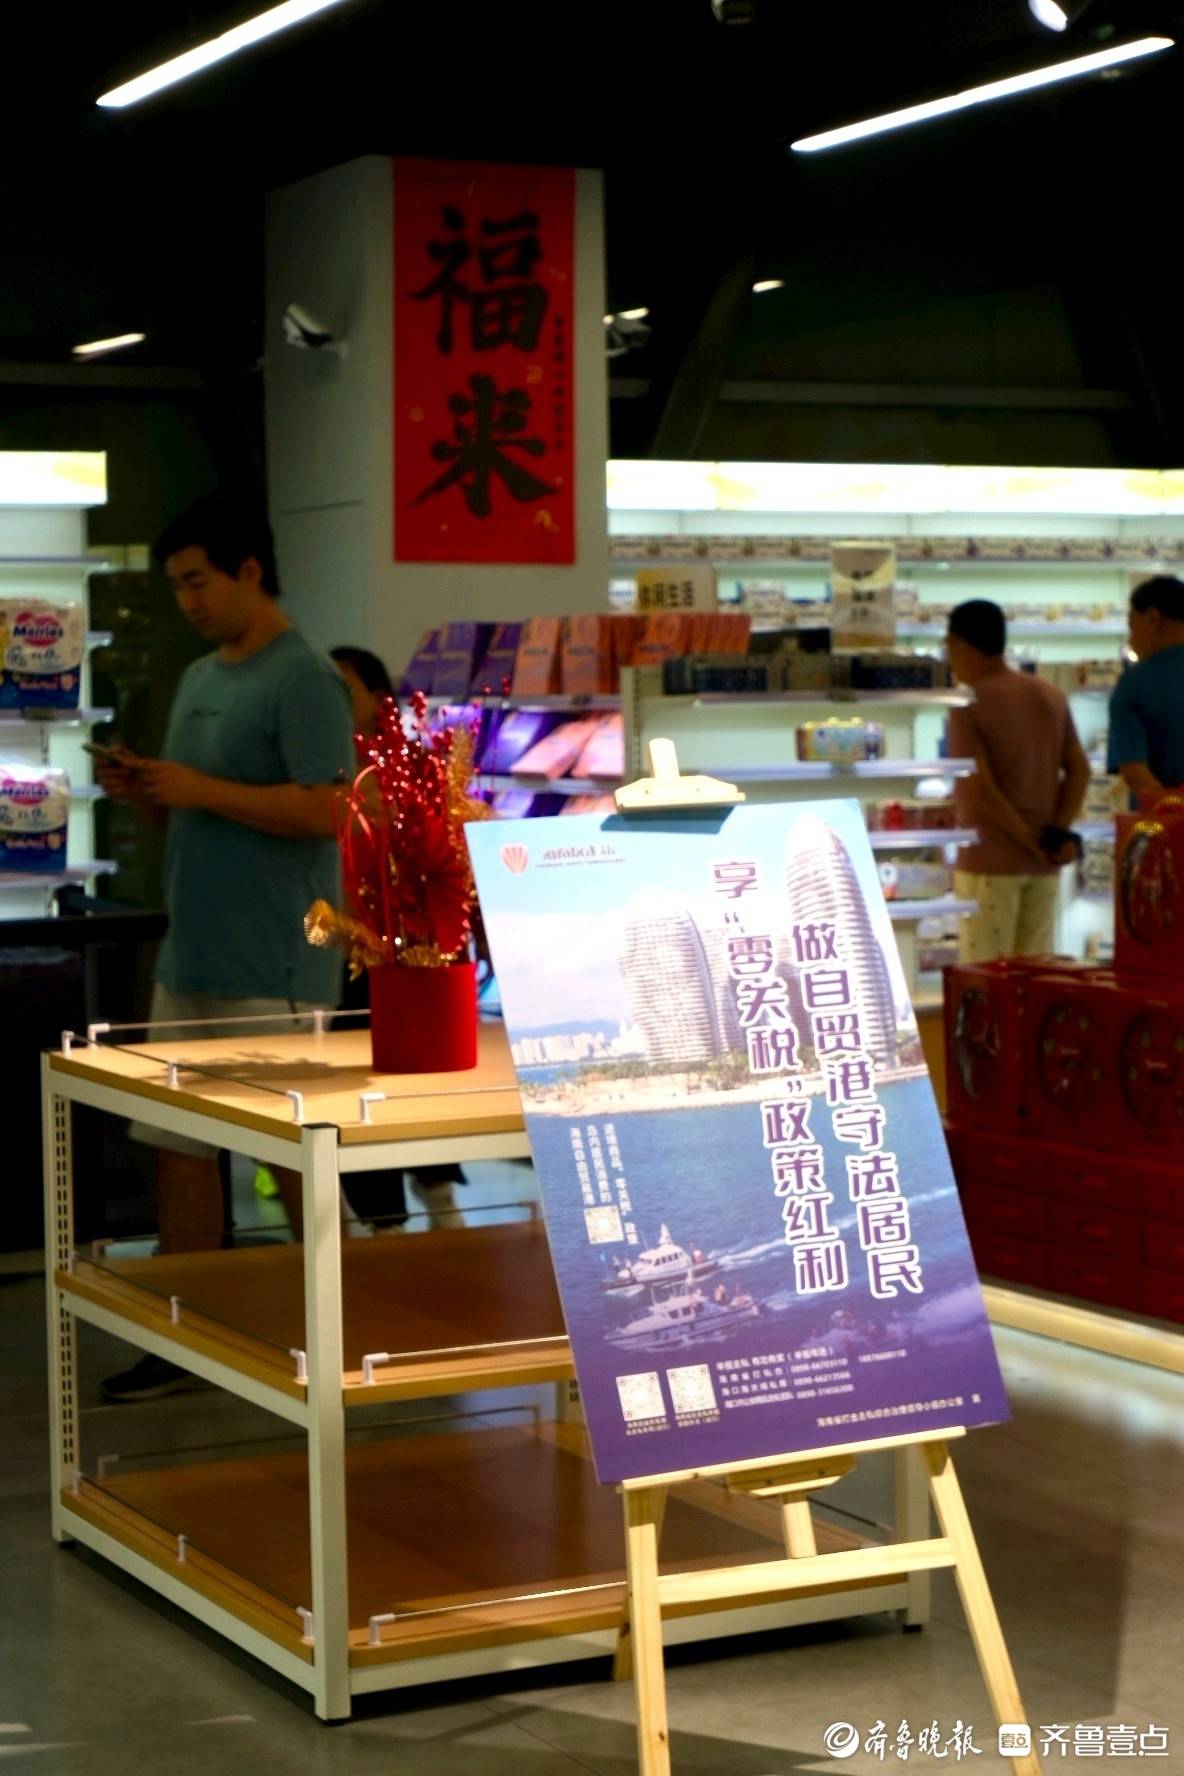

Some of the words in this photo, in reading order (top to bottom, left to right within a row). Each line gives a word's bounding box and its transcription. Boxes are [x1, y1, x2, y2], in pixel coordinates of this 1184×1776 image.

[791, 922, 923, 1298] 做自贸港守法居民
